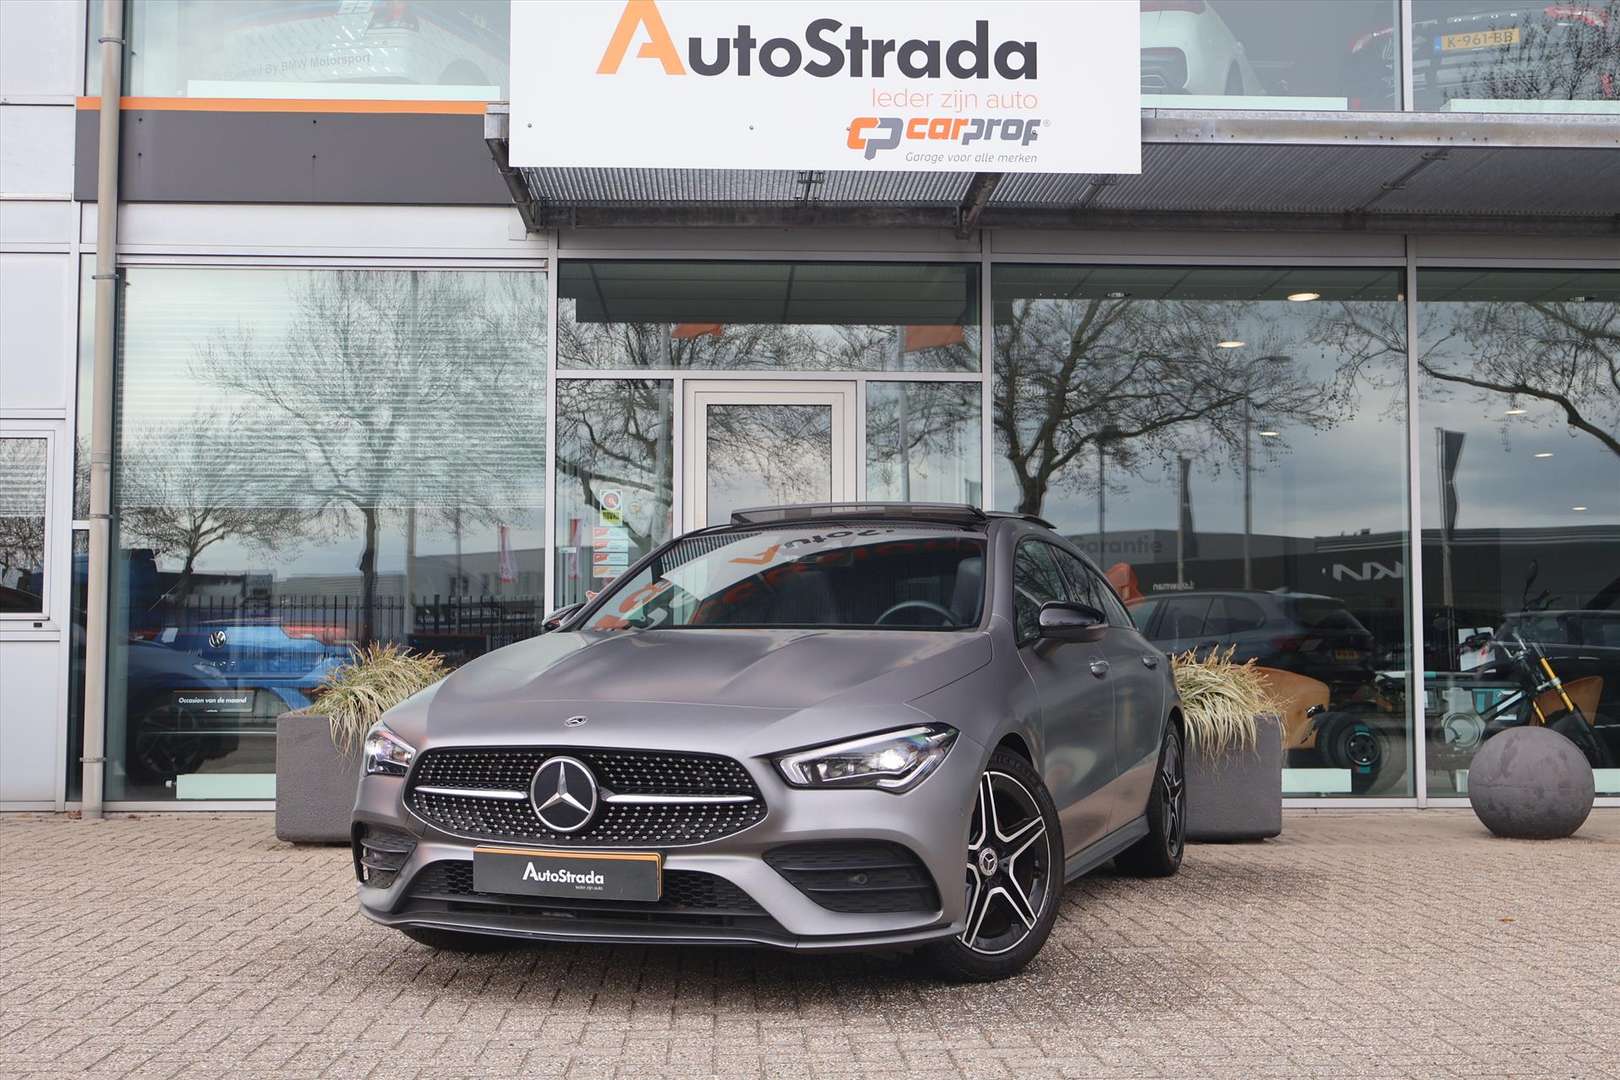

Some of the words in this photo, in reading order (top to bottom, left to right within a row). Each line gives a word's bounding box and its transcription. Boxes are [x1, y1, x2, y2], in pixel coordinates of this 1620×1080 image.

[596, 0, 1038, 81] AutoStrada
[872, 87, 934, 108] Ieder
[940, 89, 979, 113] zijn
[986, 91, 1039, 110] auto
[905, 117, 1042, 147] carprof
[905, 151, 945, 164] Garage
[947, 154, 972, 163] voor
[974, 152, 995, 163] alle
[997, 152, 1038, 164] merken
[178, 696, 204, 704] Occasion
[217, 696, 225, 704] de
[225, 696, 247, 704] maand
[522, 861, 605, 885] AutoStrada
